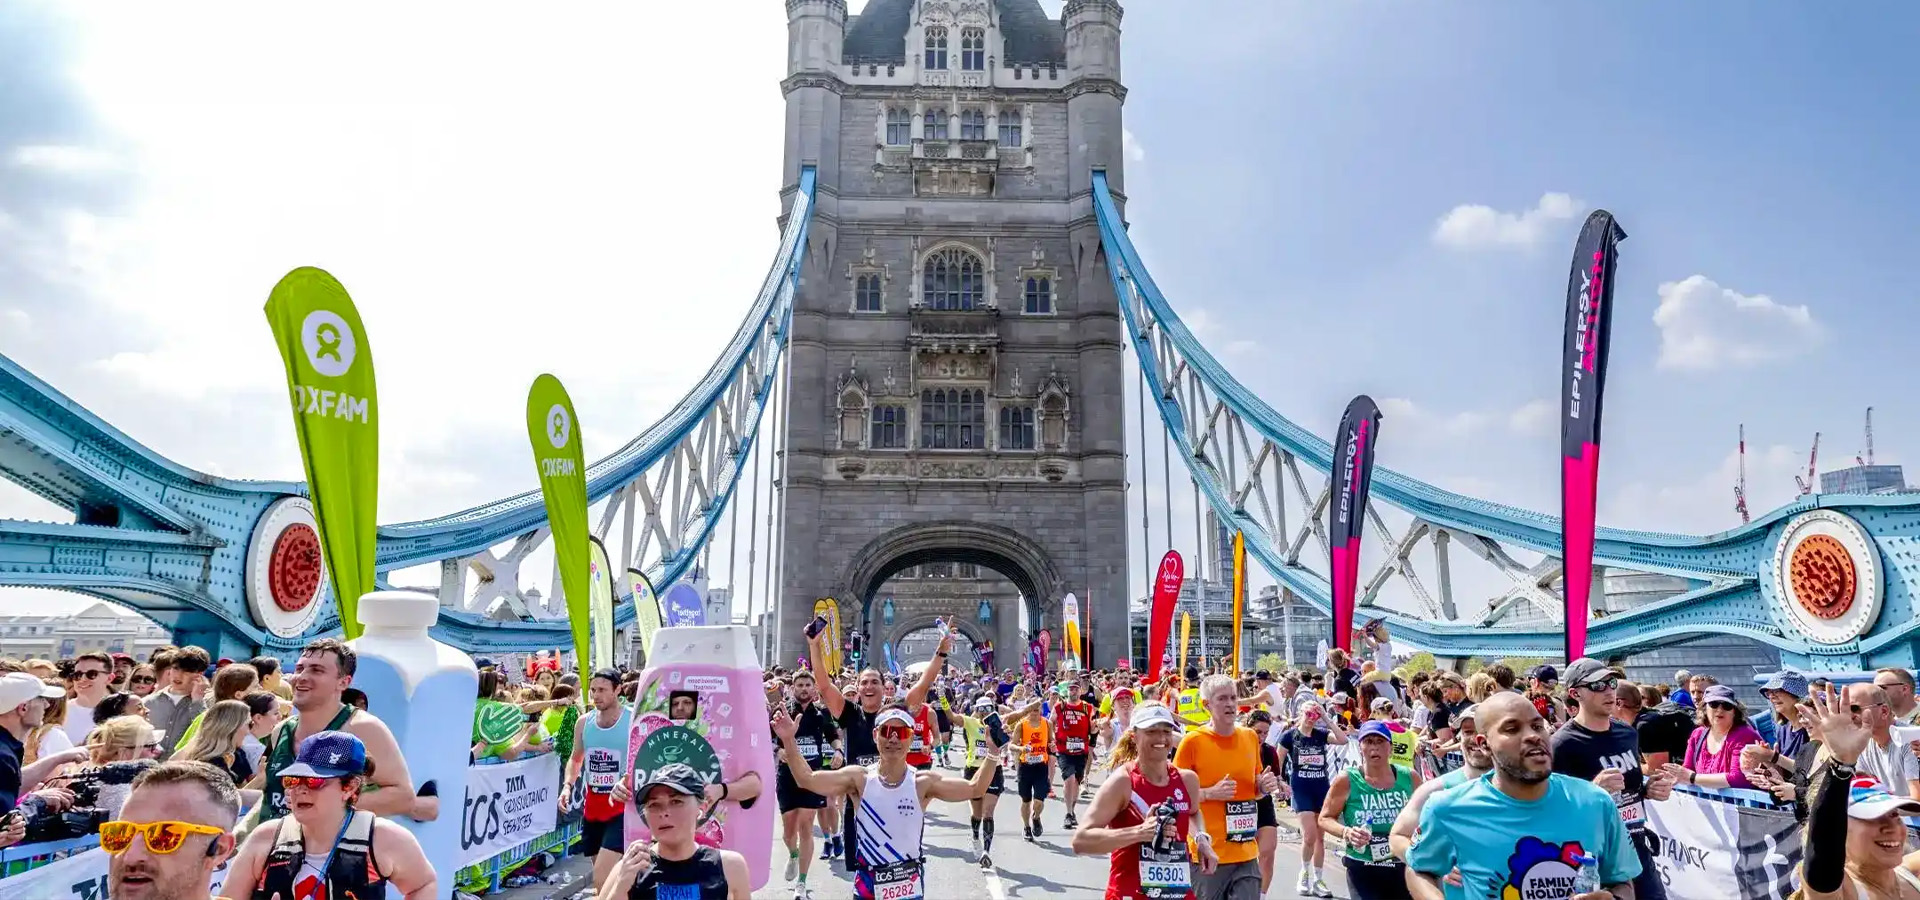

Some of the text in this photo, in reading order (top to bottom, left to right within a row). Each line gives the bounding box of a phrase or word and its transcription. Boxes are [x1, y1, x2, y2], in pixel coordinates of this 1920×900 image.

[1570, 269, 1590, 419] EPILEPSY
[293, 384, 369, 424] OXFAM
[541, 457, 577, 478] OXFAM
[1338, 428, 1359, 523] EPILEPSY
[1205, 636, 1229, 645] Inside
[1195, 647, 1224, 656] Bidge
[647, 730, 705, 753] MINERAL
[589, 752, 613, 761] BRAIN
[1298, 770, 1325, 778] GEORGIA
[505, 775, 526, 793] TATA
[503, 786, 549, 814] CONSULTANCY
[1227, 803, 1242, 814] tcs
[461, 785, 501, 850] tcs
[1232, 818, 1254, 829] 19932
[1356, 817, 1387, 825] CACER
[875, 870, 893, 882] tcs
[1148, 866, 1184, 881] 56303
[1529, 876, 1576, 889] FAMILY
[882, 883, 915, 900] 26282
